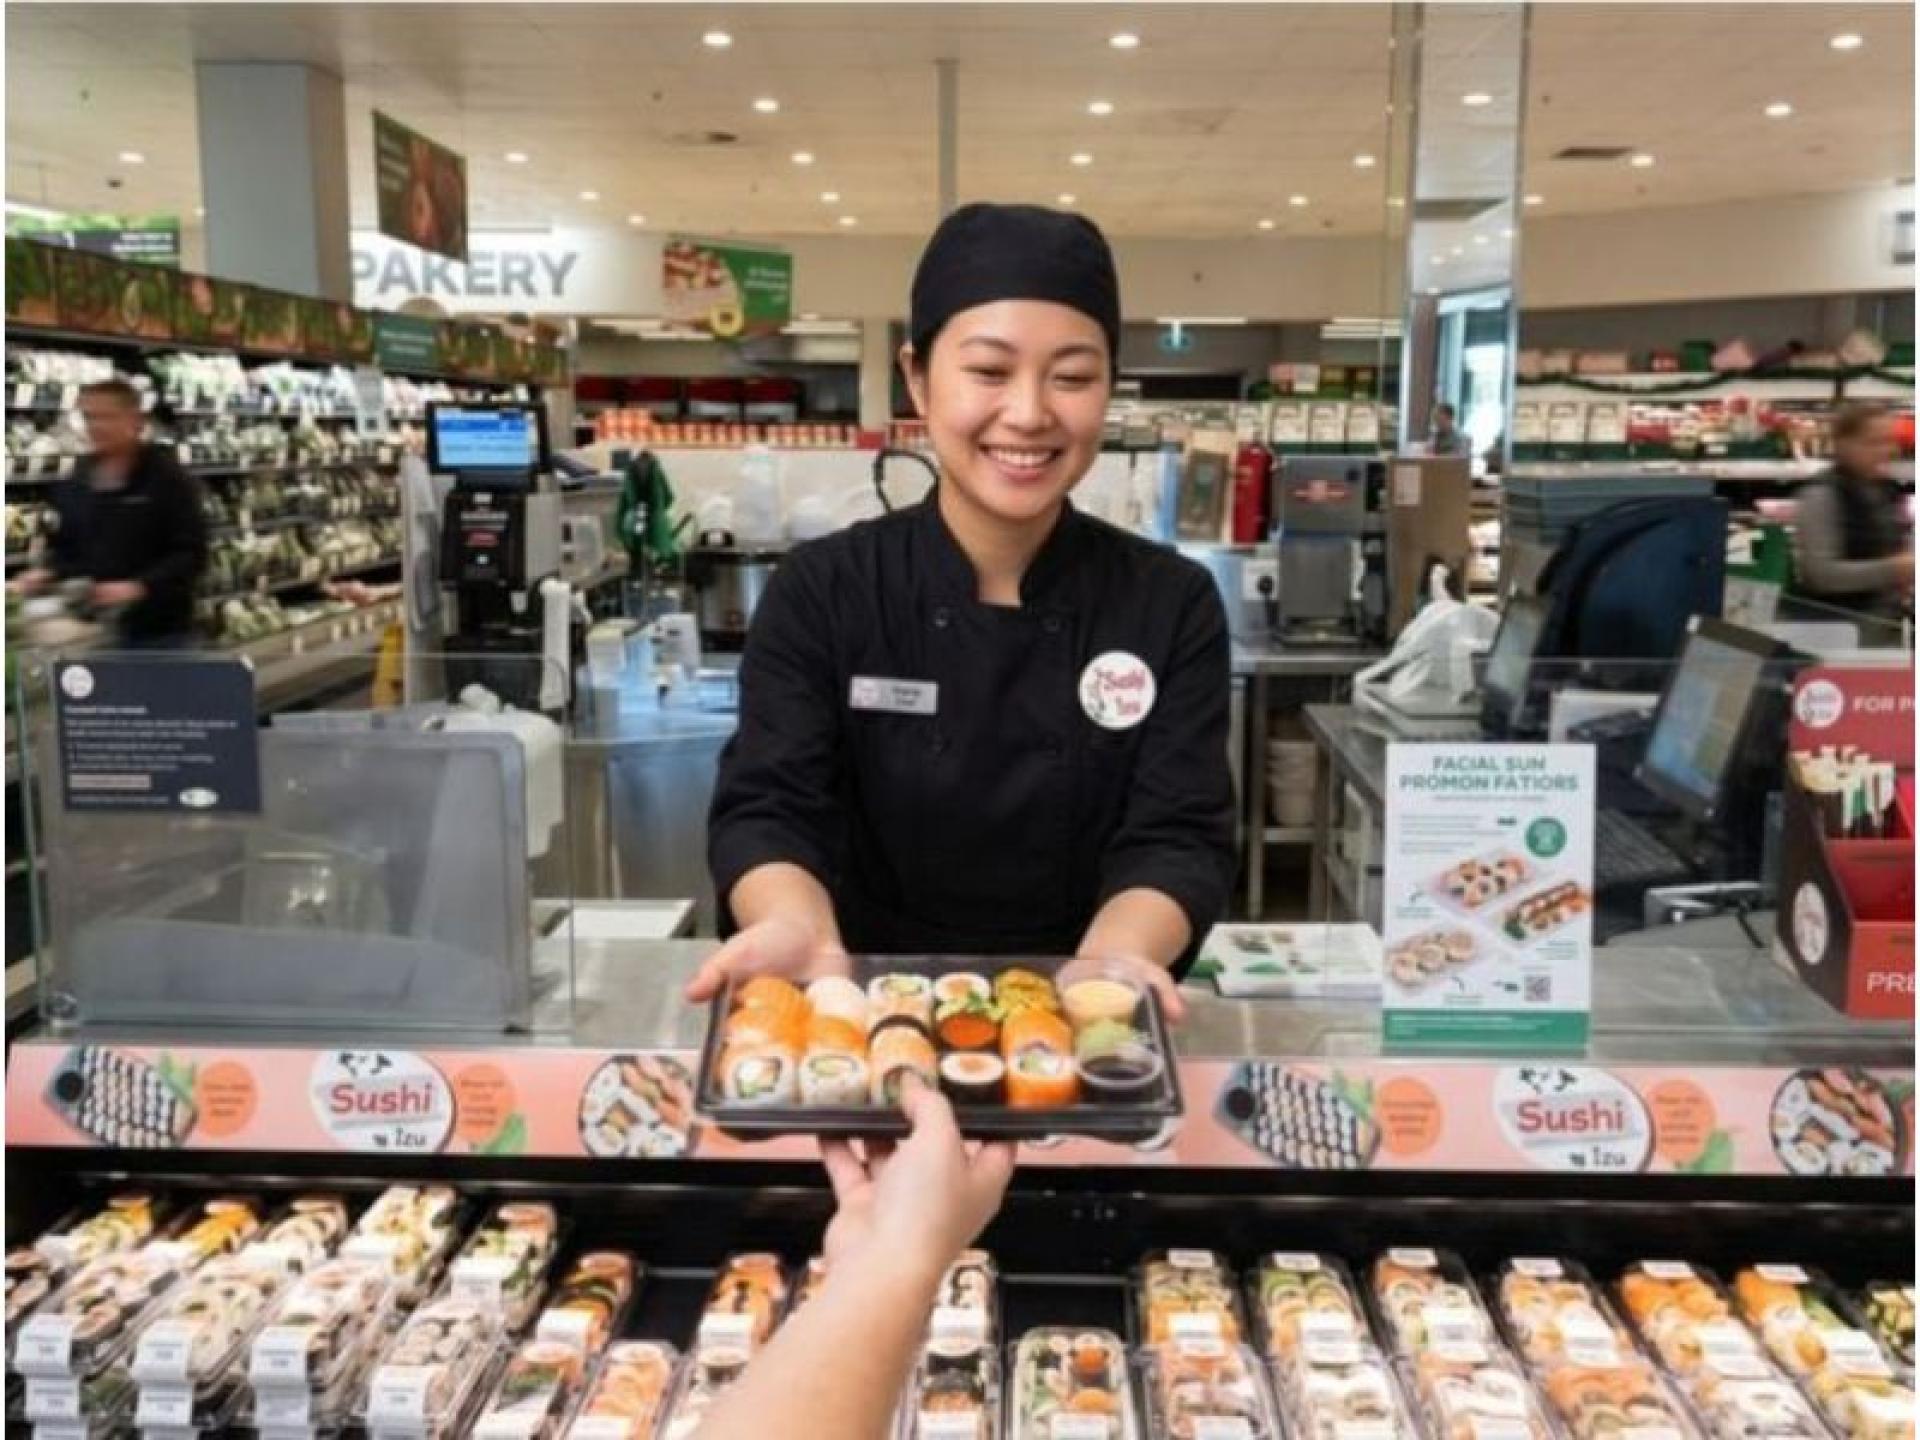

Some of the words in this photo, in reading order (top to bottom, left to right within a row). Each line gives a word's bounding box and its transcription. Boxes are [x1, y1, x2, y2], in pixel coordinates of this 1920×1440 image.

[1854, 695, 1894, 712] FOR
[1432, 756, 1499, 770] FACIAL
[1504, 756, 1546, 770] SUN
[1400, 774, 1490, 790] PROMON
[330, 1081, 433, 1114] Sushi
[1517, 1099, 1624, 1133] Sushi
[1592, 1146, 1626, 1167] Izu
